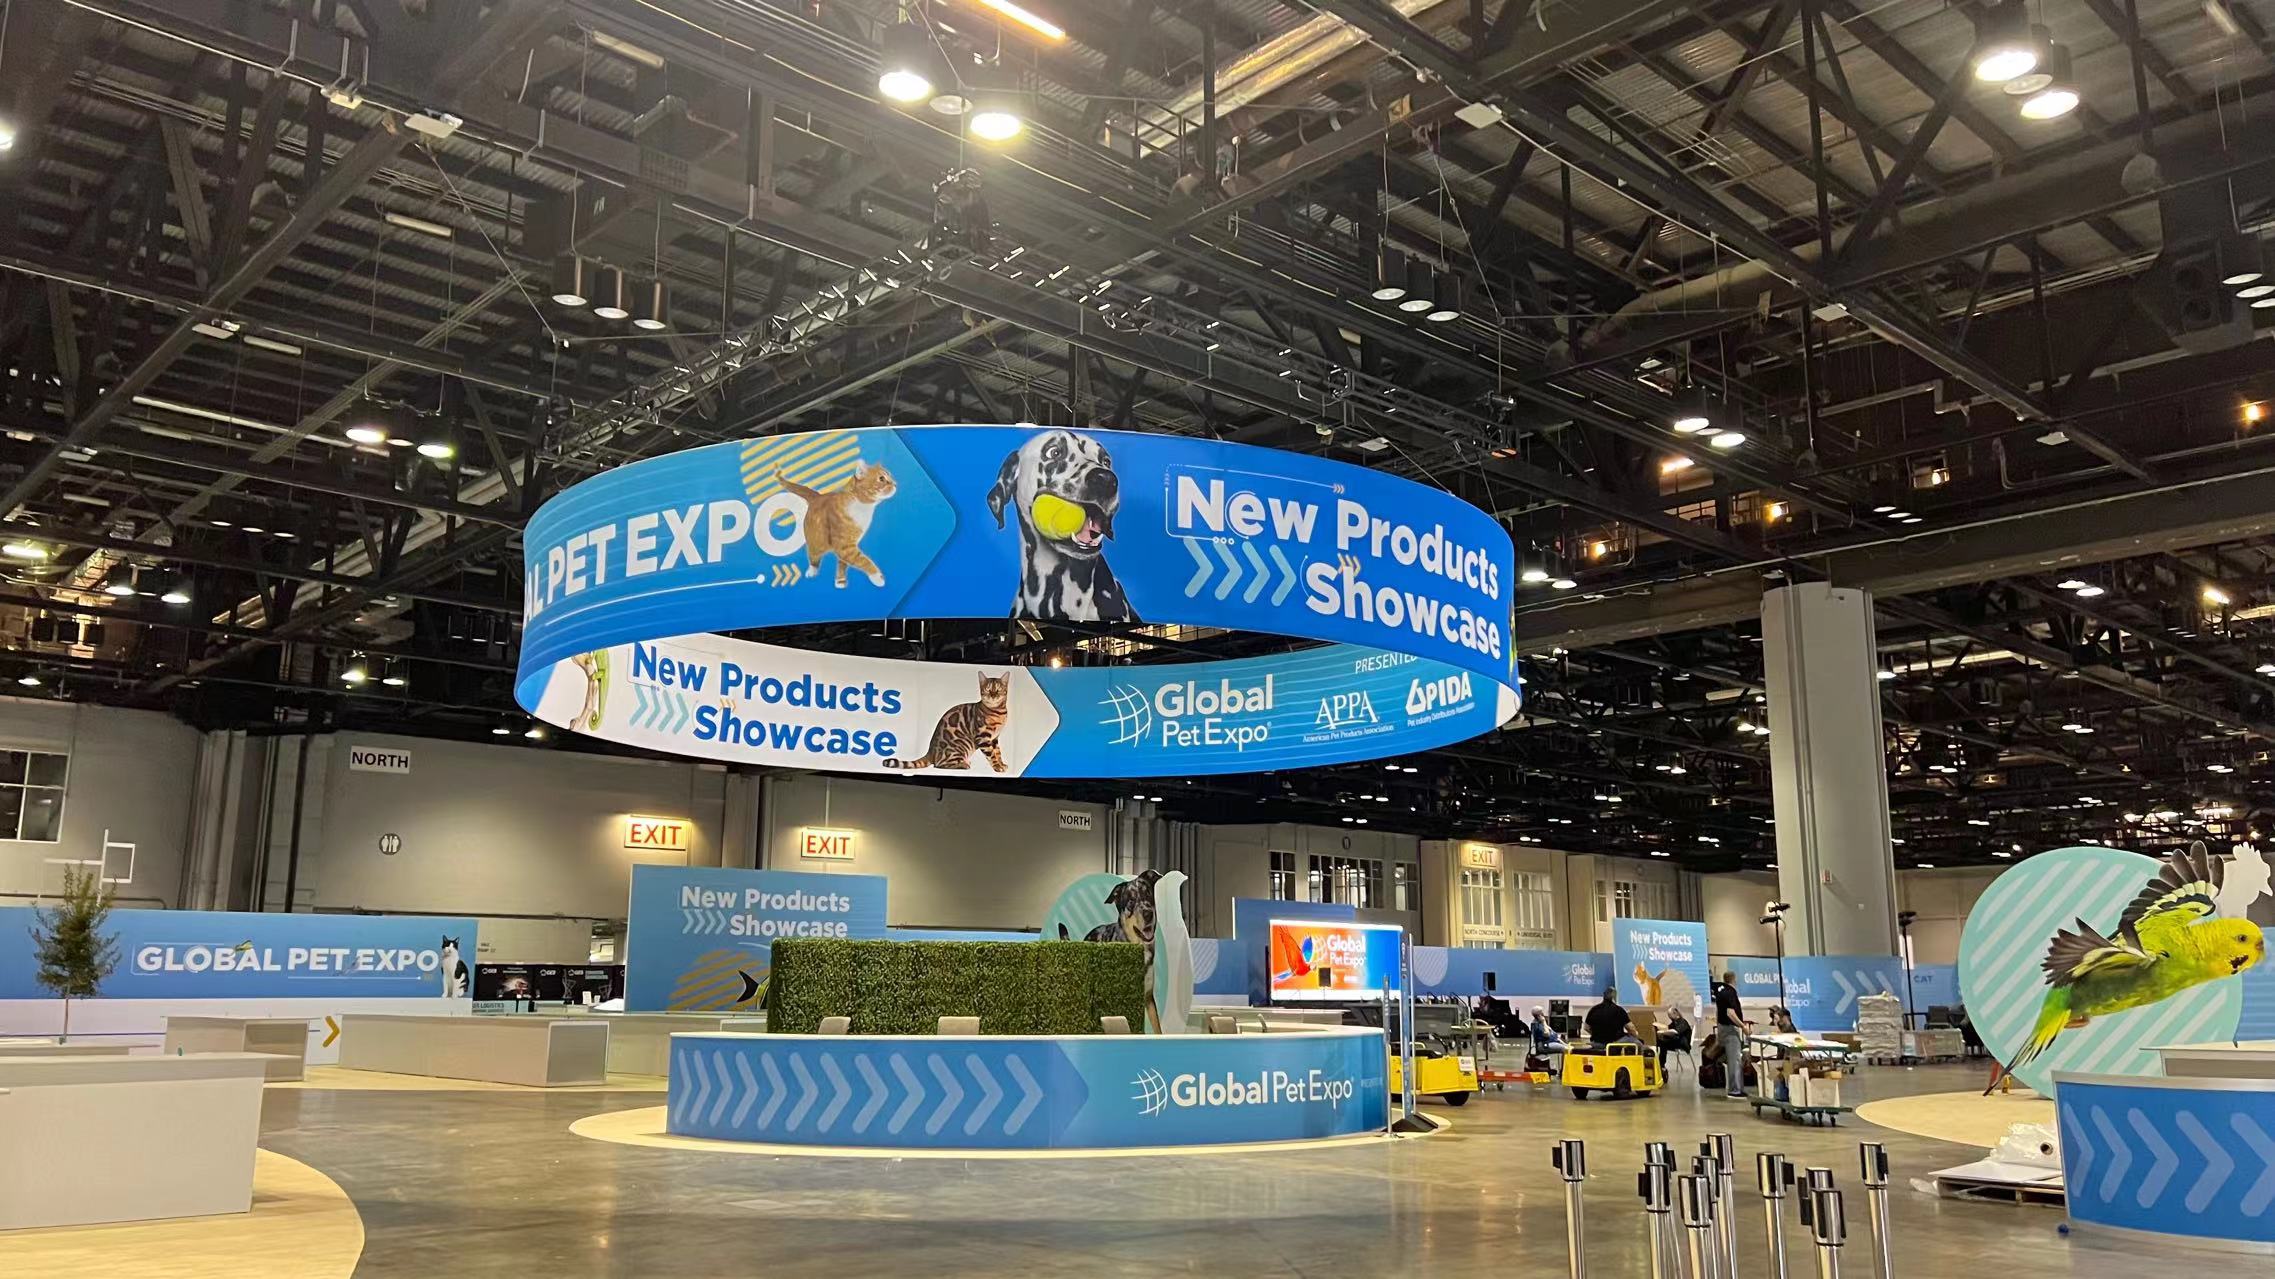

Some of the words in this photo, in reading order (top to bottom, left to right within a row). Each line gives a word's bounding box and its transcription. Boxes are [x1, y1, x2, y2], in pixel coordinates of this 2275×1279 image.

[547, 524, 616, 604] PET
[626, 493, 807, 577] EXPO
[1177, 476, 1318, 544] New
[1337, 499, 1499, 600] Products
[1306, 557, 1501, 660] Showcase
[633, 643, 707, 691] New
[720, 662, 901, 714] Products
[1155, 674, 1273, 717] Global
[1315, 690, 1378, 729] APPA
[693, 705, 898, 756] Showcase
[1163, 720, 1200, 747] Pet
[1205, 718, 1268, 752] Expo
[352, 750, 409, 769] NORTH
[1059, 812, 1091, 828] NORTH
[630, 823, 681, 845] EXIT
[806, 835, 850, 856] EXIT
[1472, 849, 1494, 864] EXIT
[682, 886, 737, 908] New
[745, 889, 849, 912] Products
[730, 914, 848, 937] Showcase
[1327, 934, 1366, 952] Global
[1630, 930, 1650, 944] New
[1652, 931, 1692, 946] Products
[137, 946, 281, 973] GLOBAL
[288, 948, 349, 972] PET
[356, 948, 439, 972] EXPO
[1330, 952, 1343, 965] Pet
[1344, 953, 1364, 967] Expo
[1649, 947, 1693, 961] Showcase
[1571, 963, 1595, 976] Global
[1744, 972, 1773, 984] GLOBAL
[1913, 975, 1933, 983] CAT
[1171, 1071, 1268, 1107] Global
[1272, 1071, 1305, 1103] Pet
[1309, 1070, 1352, 1109] Expo
